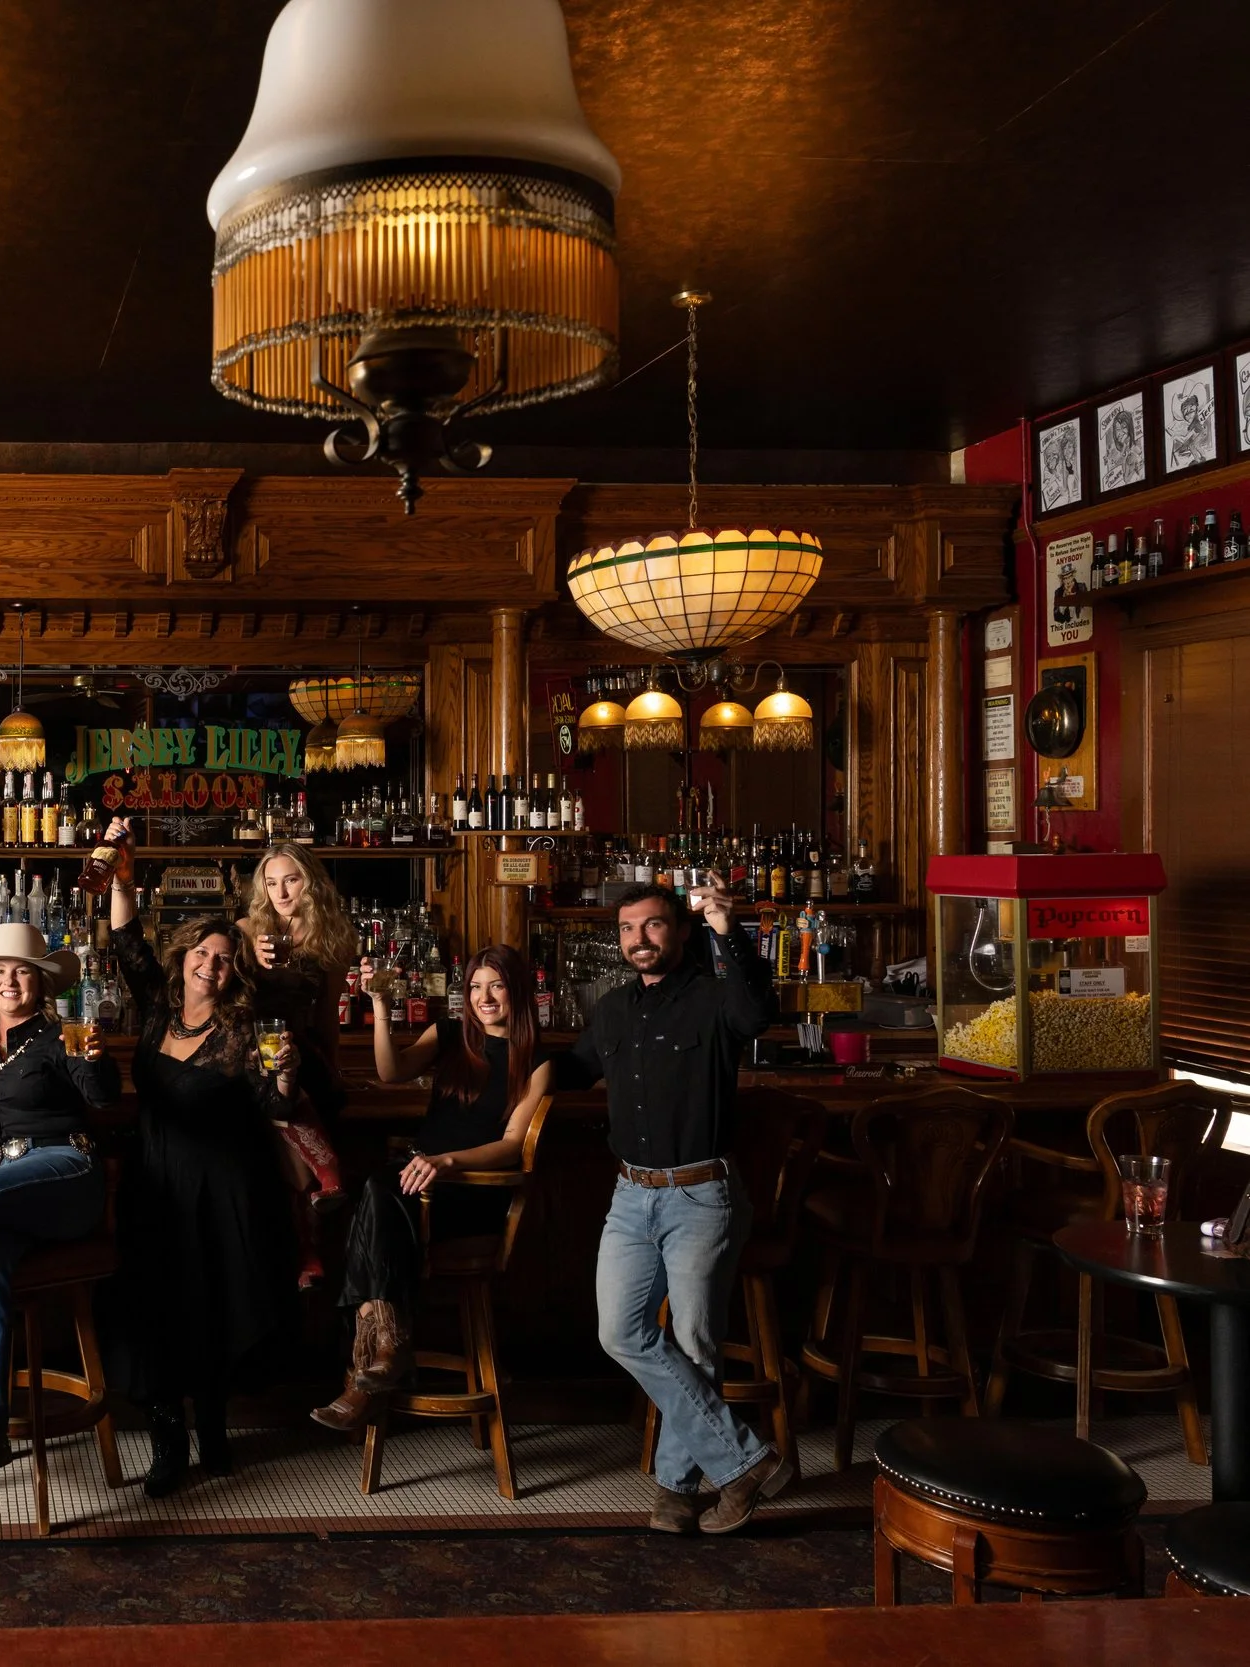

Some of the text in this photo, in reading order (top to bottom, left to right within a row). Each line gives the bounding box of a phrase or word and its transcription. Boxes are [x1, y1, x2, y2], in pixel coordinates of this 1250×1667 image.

[1080, 536, 1091, 544] Right
[1056, 553, 1083, 565] ANYBODY
[1050, 618, 1090, 632] This Includes
[1061, 630, 1079, 641] YOU
[65, 725, 303, 784] JERSEY LILLY
[102, 772, 266, 812] SALOON
[170, 879, 217, 888] THANK YOU
[1032, 907, 1147, 928] Popcorn
